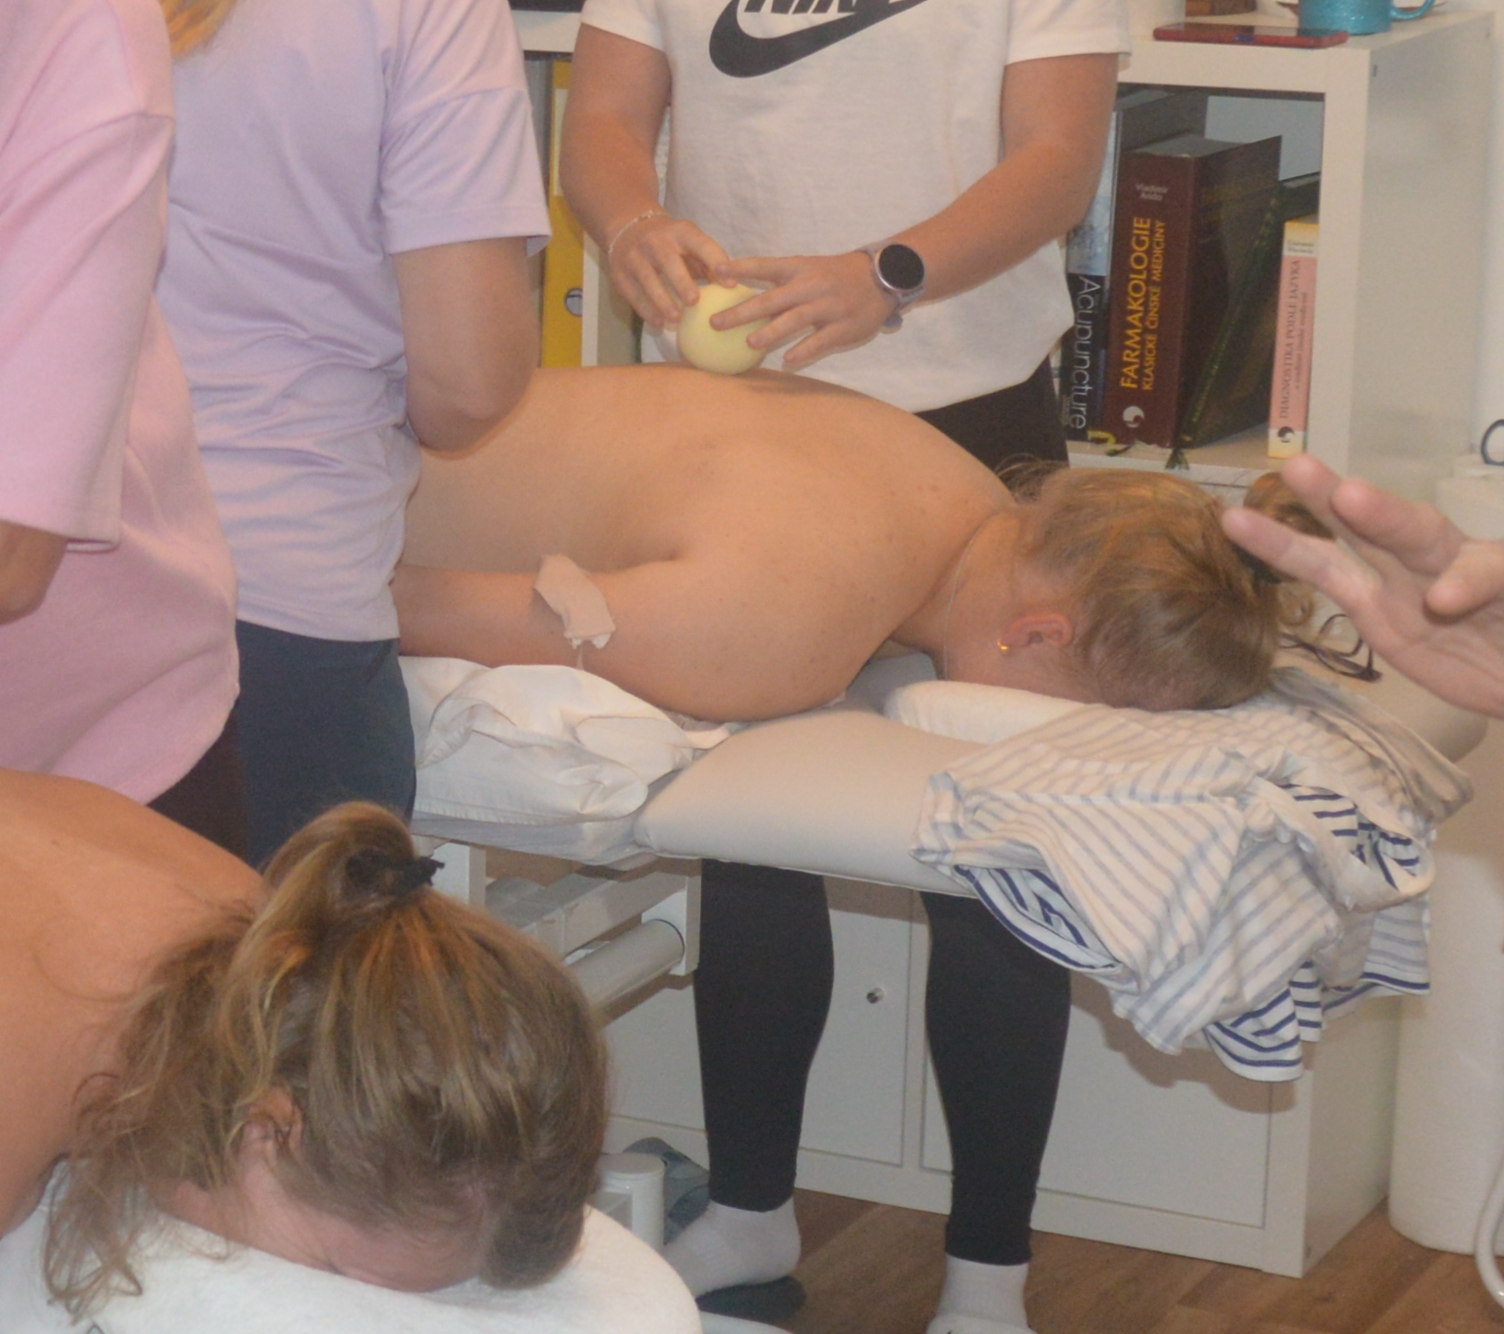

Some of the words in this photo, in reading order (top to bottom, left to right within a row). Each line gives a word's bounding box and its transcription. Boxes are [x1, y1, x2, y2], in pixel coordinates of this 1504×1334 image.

[1152, 219, 1167, 281] MEDICÍNY
[1290, 259, 1301, 300] JAZYKA
[1121, 217, 1150, 388] FARMAKOLOGIE
[1146, 285, 1162, 329] ČÍNSKÉ
[1287, 304, 1297, 339] PODLE
[1071, 276, 1100, 429] Acupuncture
[1143, 333, 1159, 391] KLASICKÉ
[1280, 342, 1295, 418] DIAGNOSTIKA
